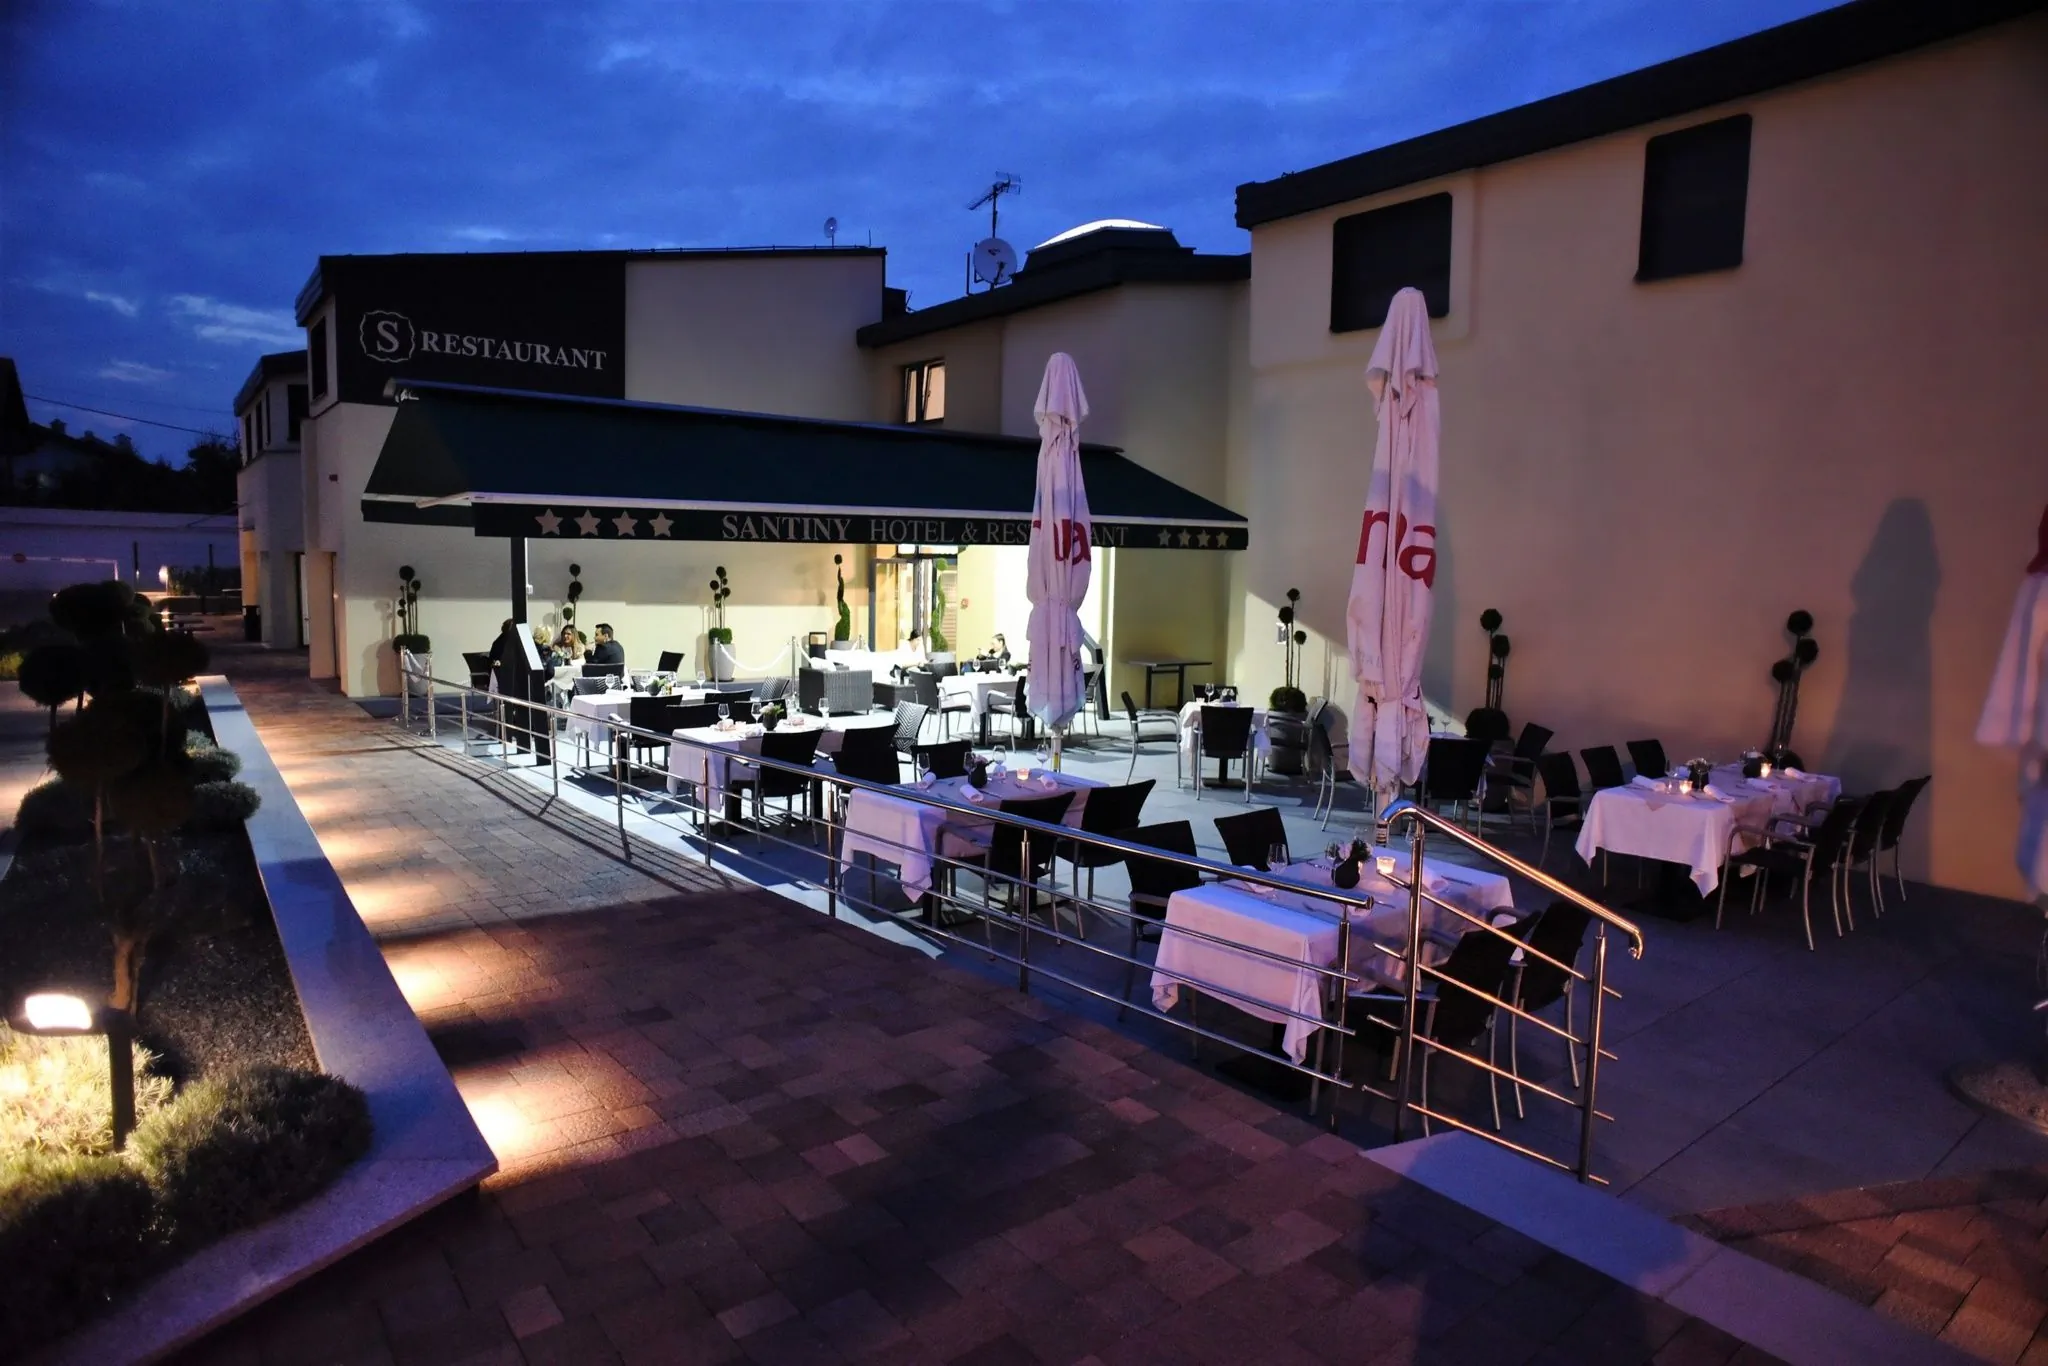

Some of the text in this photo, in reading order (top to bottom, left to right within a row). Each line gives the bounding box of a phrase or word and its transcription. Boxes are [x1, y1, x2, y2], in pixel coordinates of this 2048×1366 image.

[376, 319, 607, 370] S RESTAURANT
[721, 514, 850, 541] SANTINY
[869, 519, 954, 542] HOTEL
[960, 521, 979, 543] &
